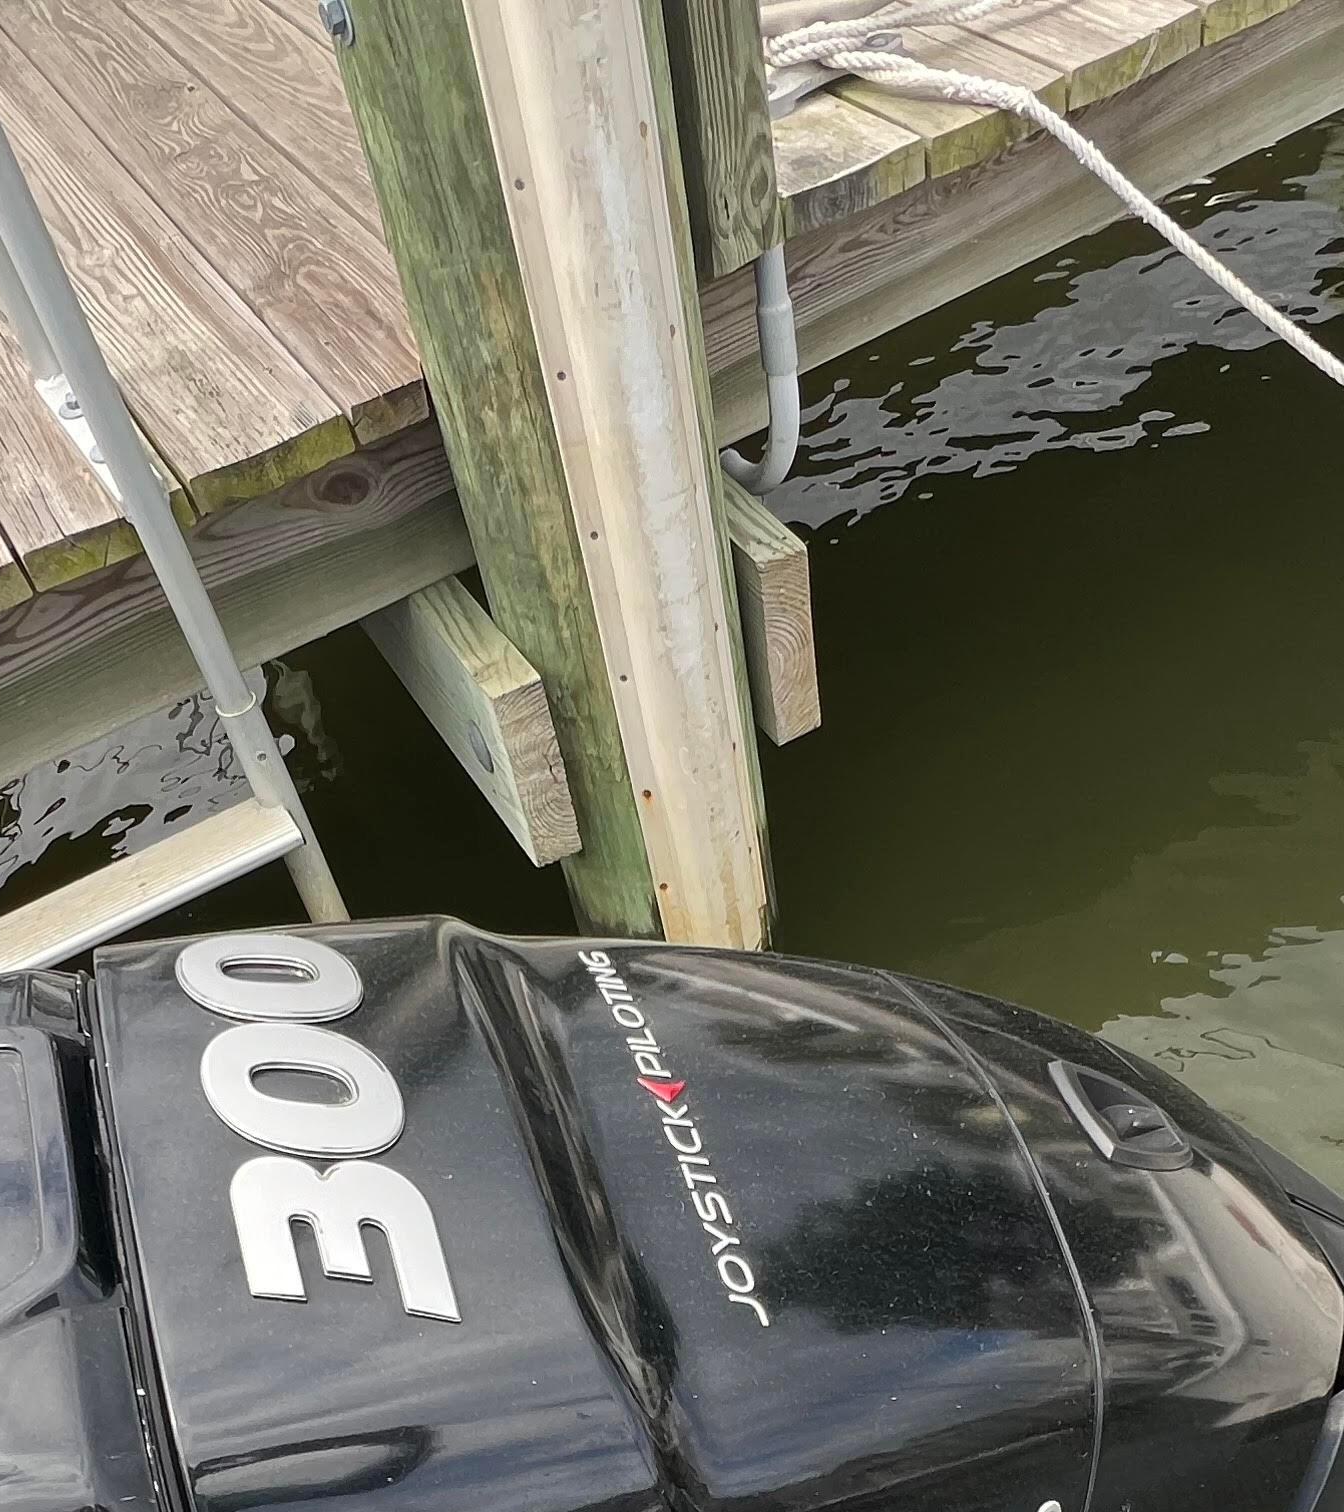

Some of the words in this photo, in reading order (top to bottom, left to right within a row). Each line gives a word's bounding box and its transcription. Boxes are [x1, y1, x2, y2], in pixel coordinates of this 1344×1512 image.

[174, 933, 462, 1322] 300
[578, 950, 672, 1079] PILOTING
[657, 1099, 770, 1328] JOYSTICK
